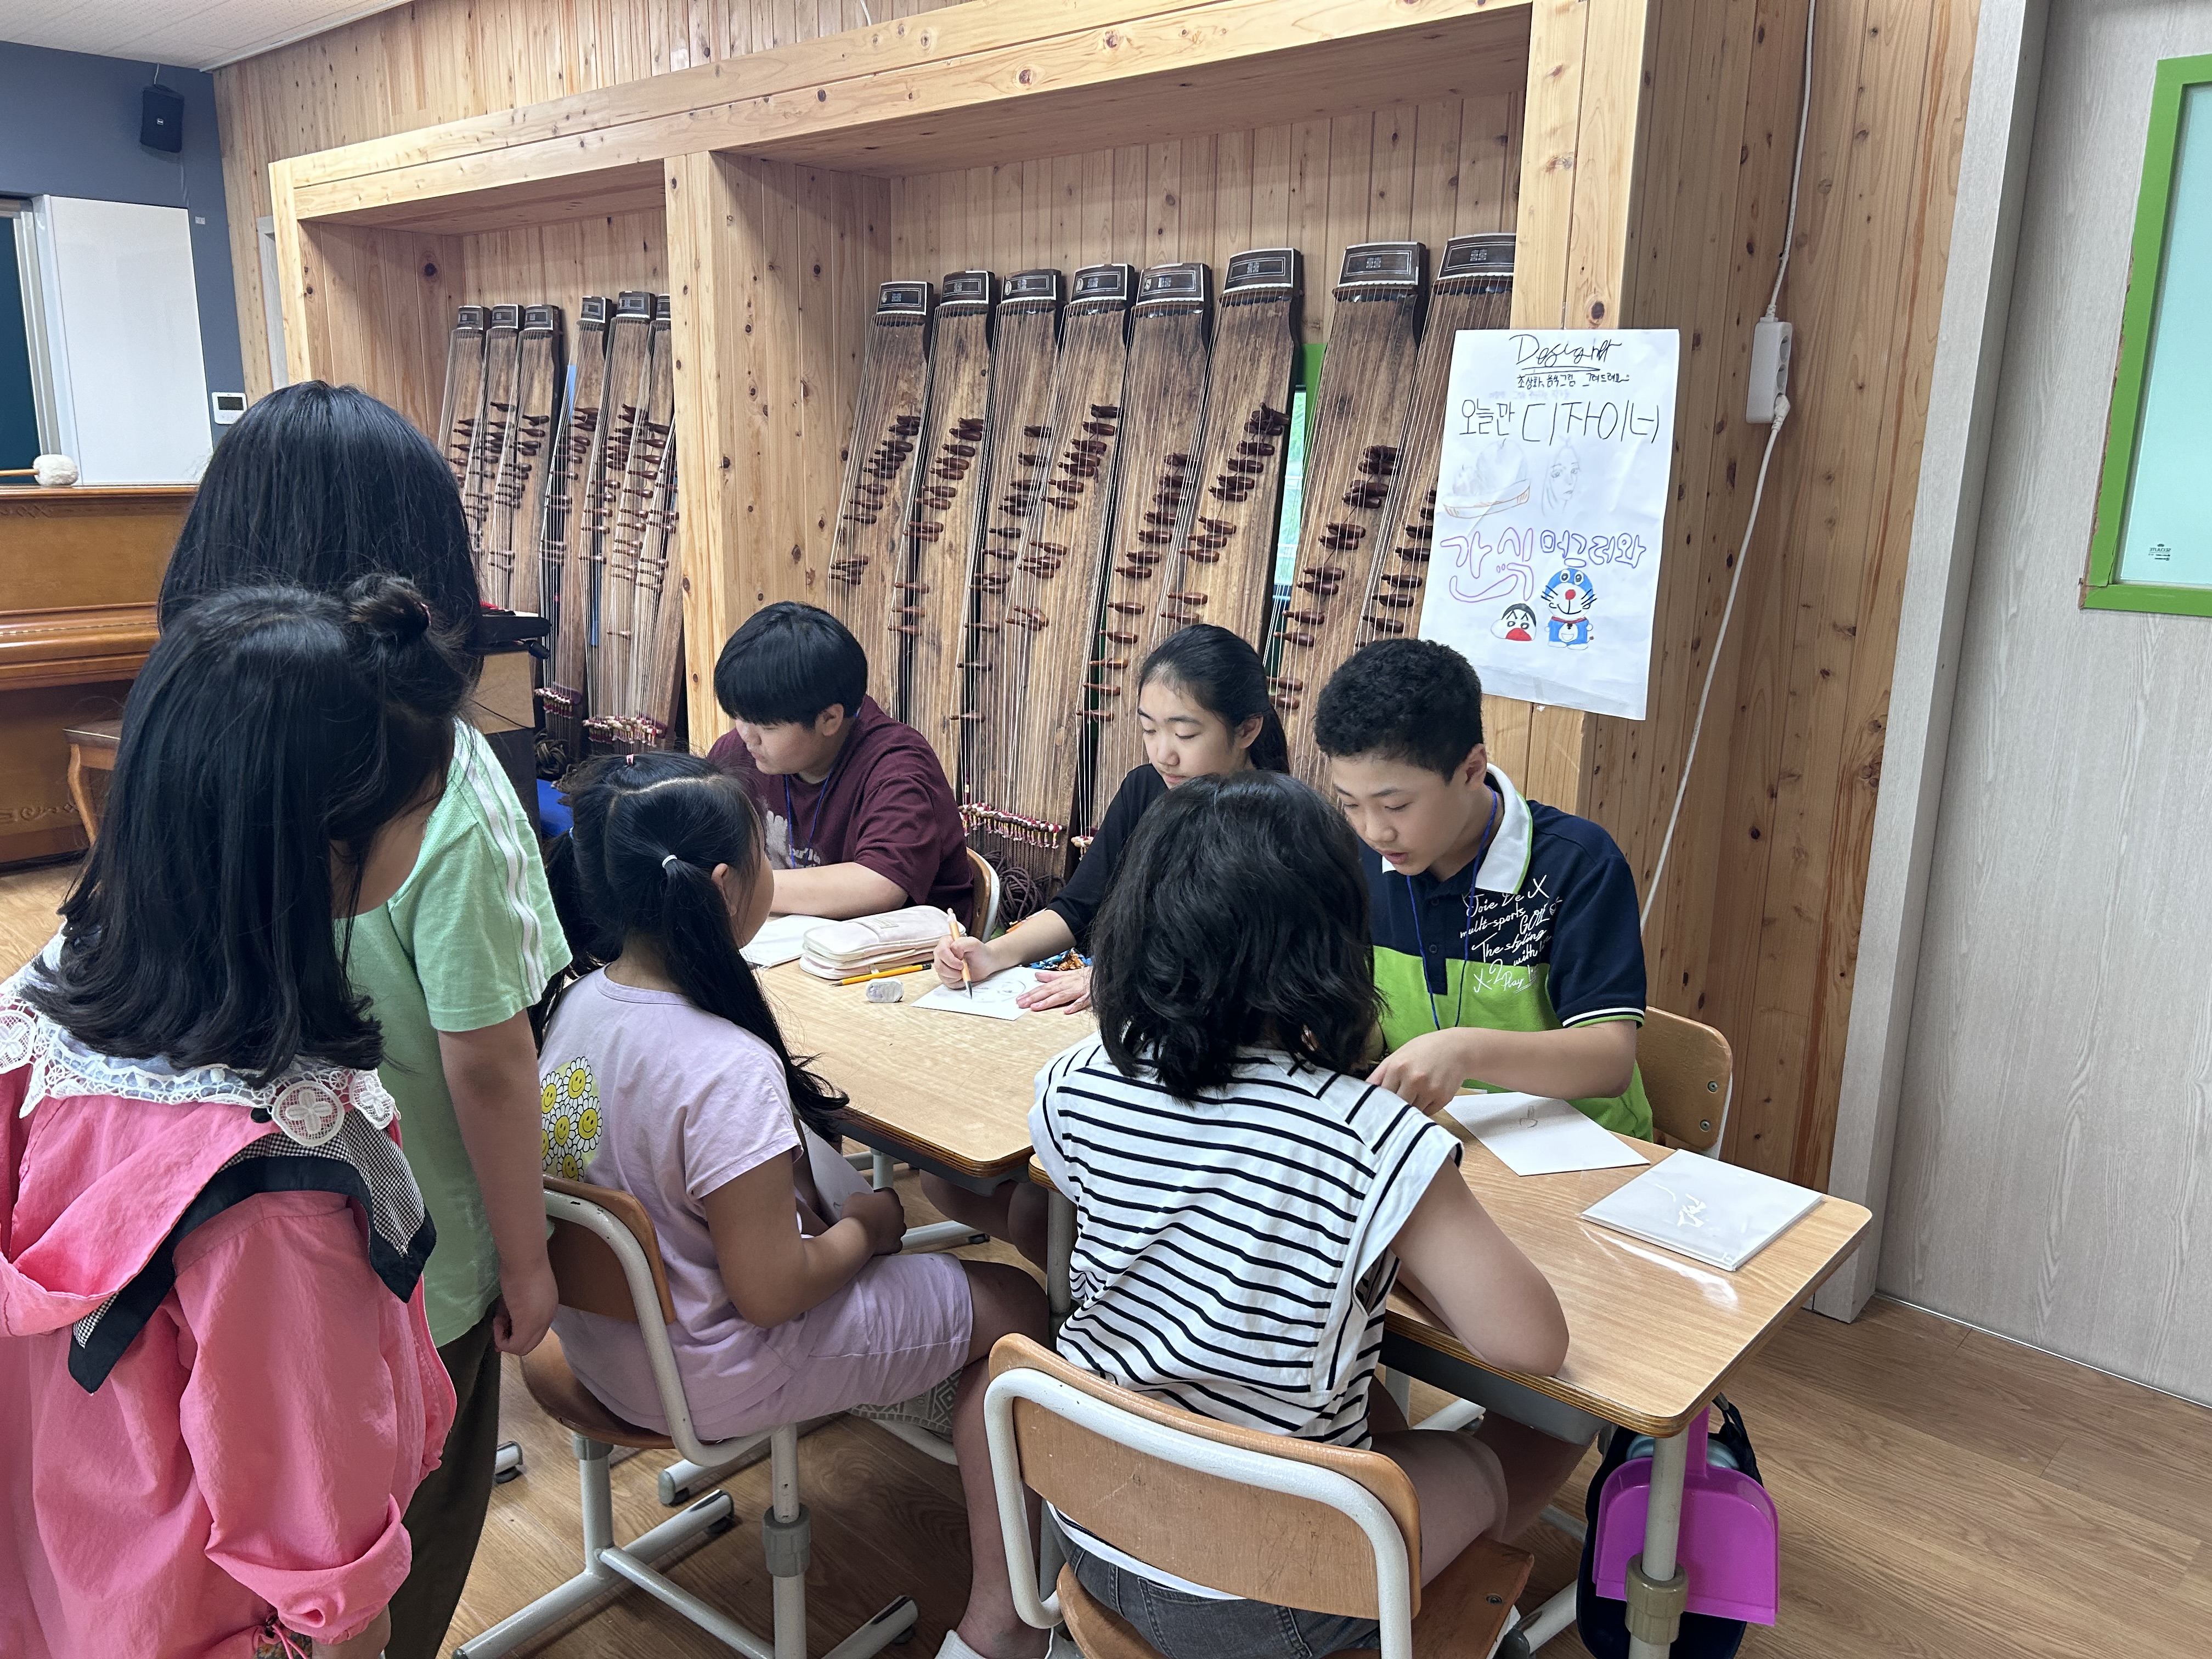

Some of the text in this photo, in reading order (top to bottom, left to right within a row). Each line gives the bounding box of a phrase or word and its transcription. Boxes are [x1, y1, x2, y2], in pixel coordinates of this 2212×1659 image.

[1459, 398, 1659, 446] 오늘만 디자이너
[1466, 894, 1498, 917] Joie
[1471, 932, 1504, 962] The
[1504, 929, 1547, 953] styling
[1513, 944, 1538, 966] with
